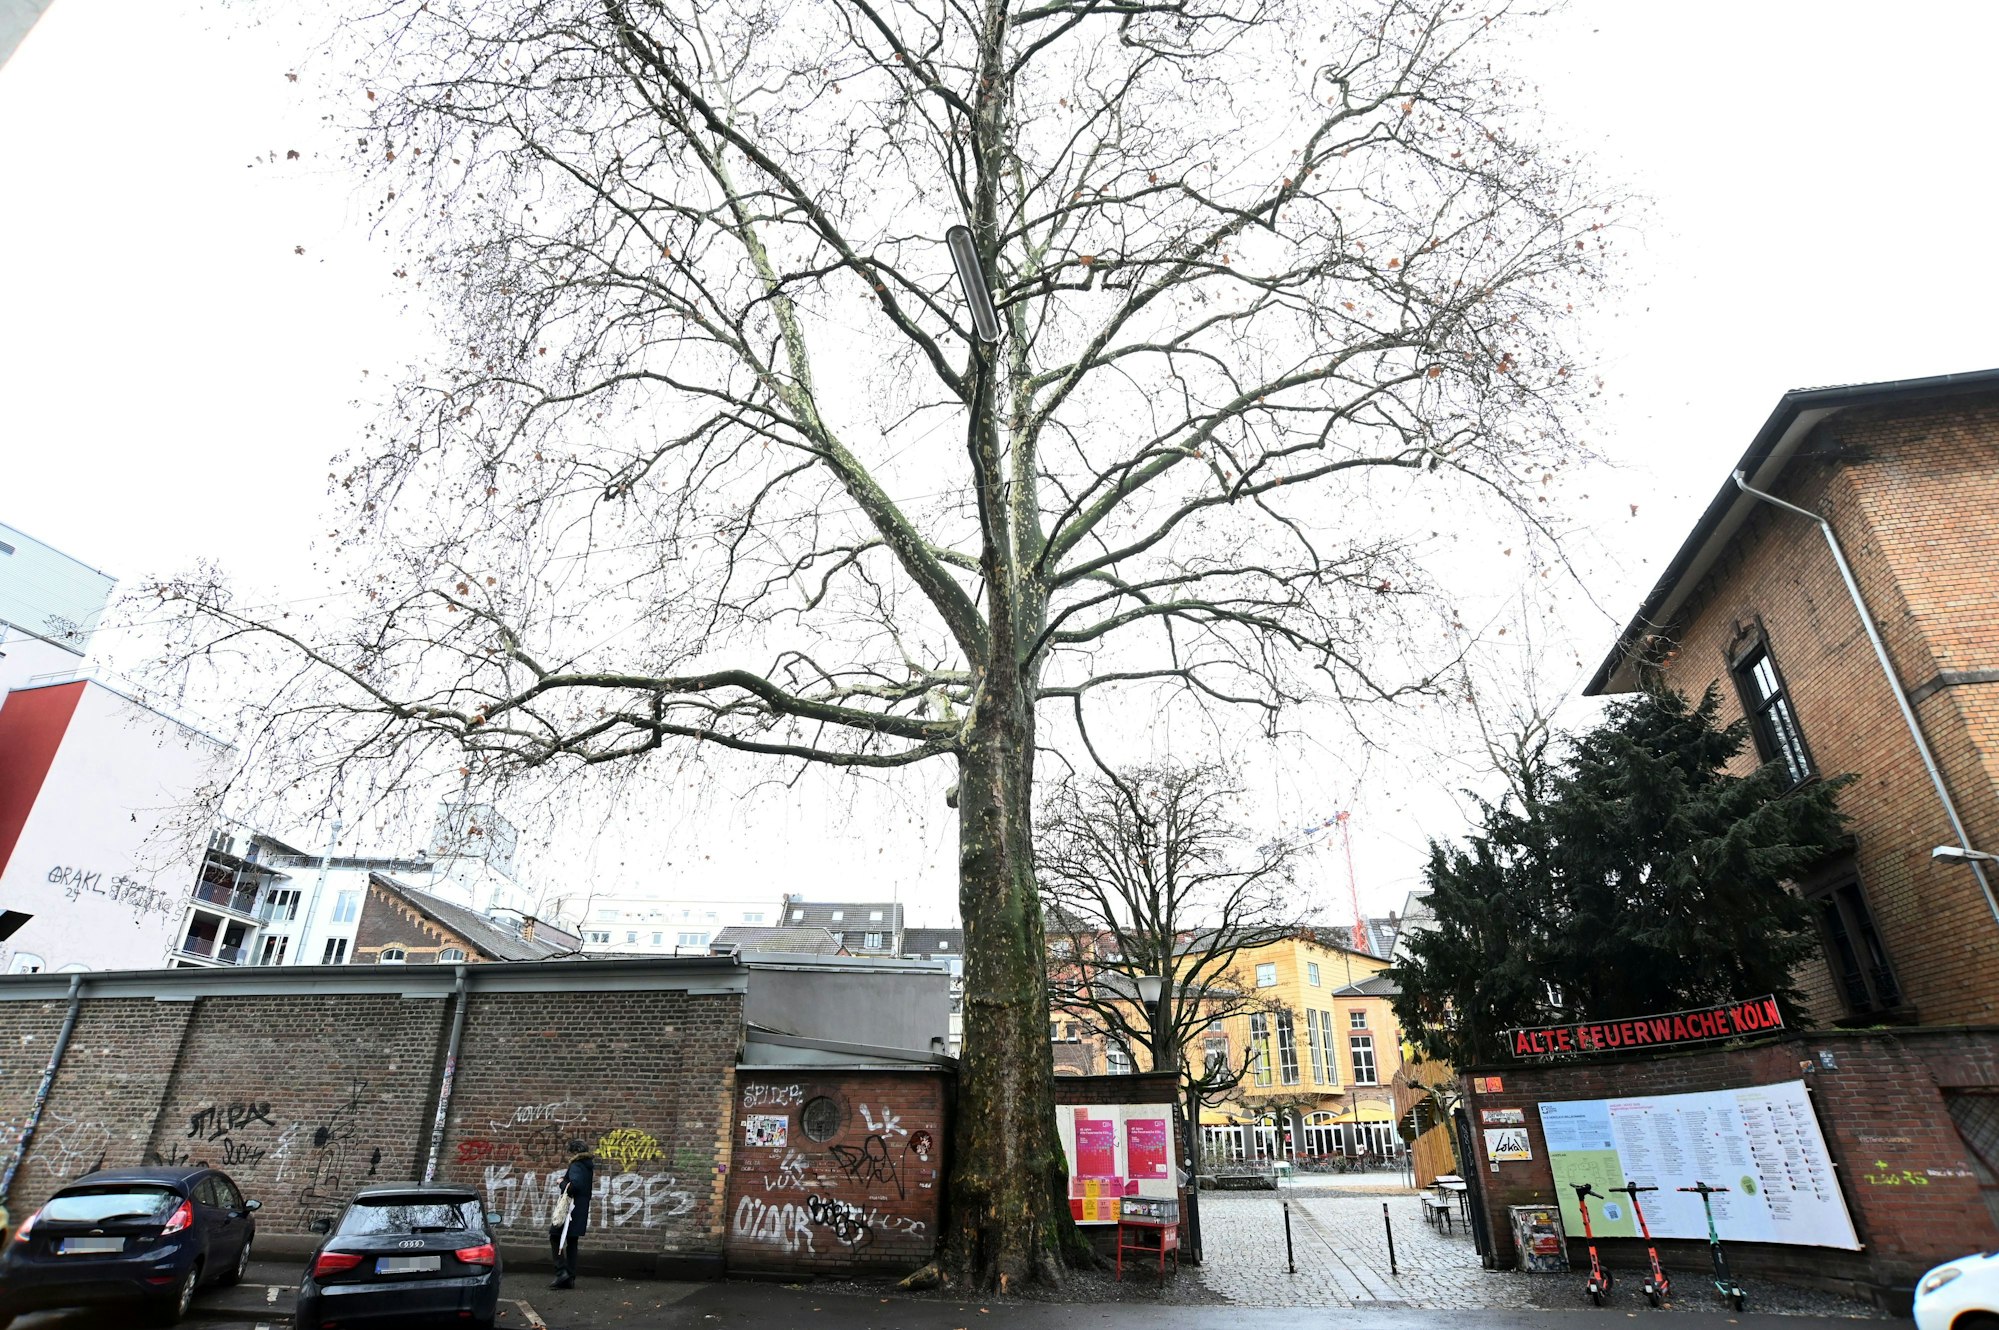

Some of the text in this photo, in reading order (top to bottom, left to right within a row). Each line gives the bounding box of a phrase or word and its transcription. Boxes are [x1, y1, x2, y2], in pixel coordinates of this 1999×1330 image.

[1516, 1000, 1780, 1054] ALTE FEUERWACHE KÖLN
